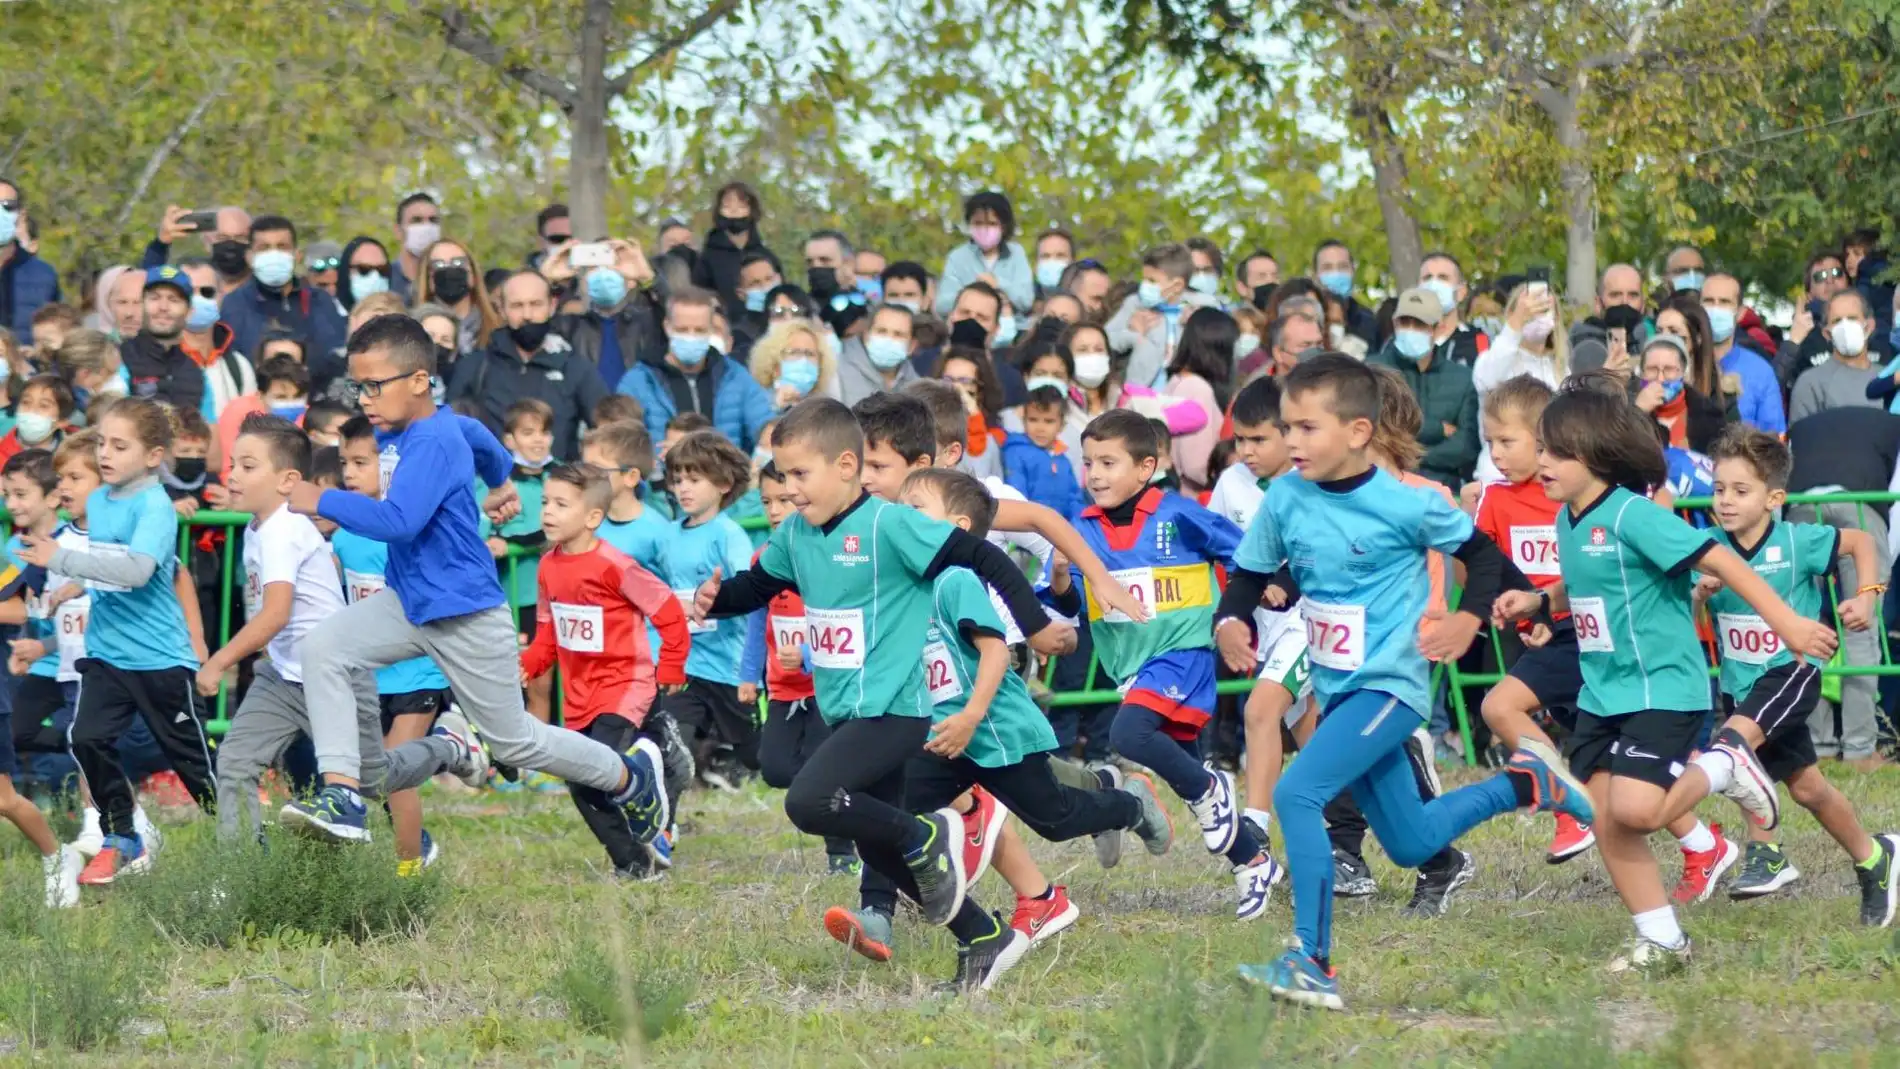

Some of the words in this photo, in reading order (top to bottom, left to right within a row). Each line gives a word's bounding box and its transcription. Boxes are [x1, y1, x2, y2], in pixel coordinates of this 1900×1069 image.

[1154, 578, 1182, 603] RAL
[559, 616, 594, 641] 078
[810, 624, 856, 655] 042
[1306, 616, 1351, 654] 072
[1728, 627, 1779, 654] 009
